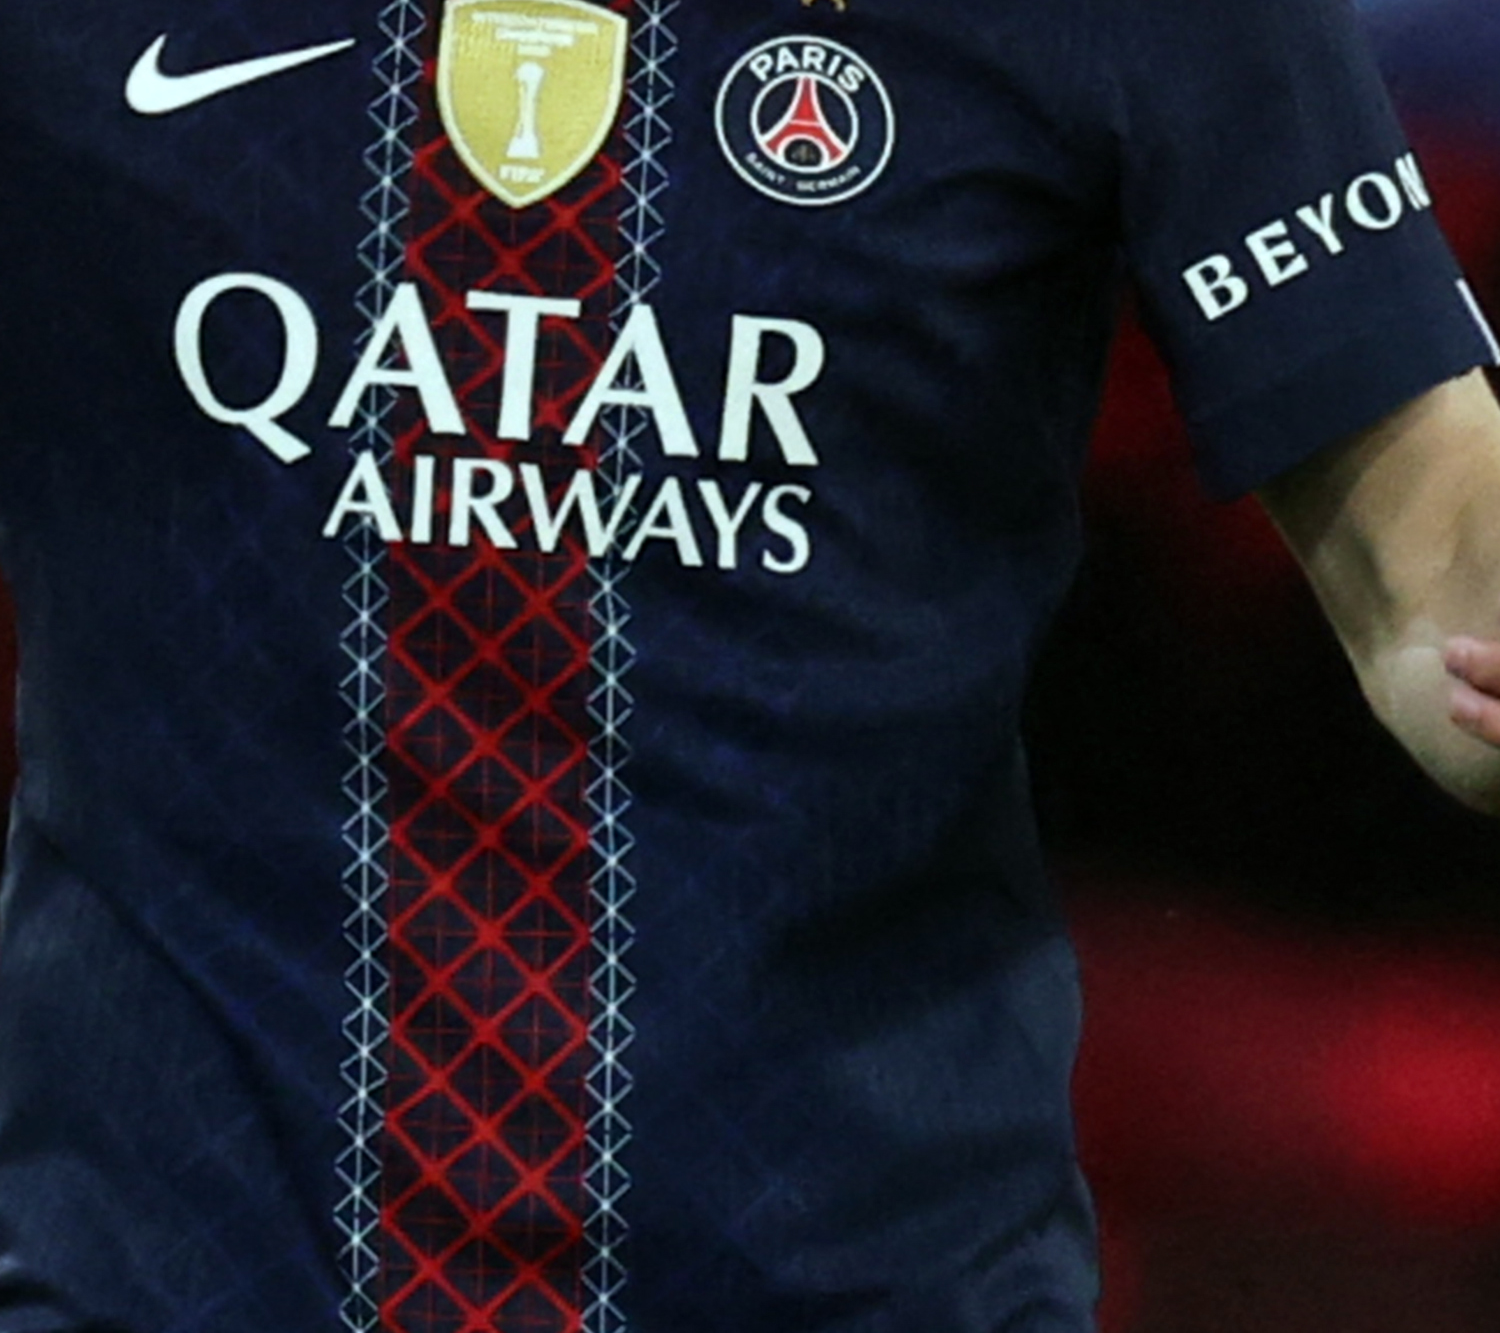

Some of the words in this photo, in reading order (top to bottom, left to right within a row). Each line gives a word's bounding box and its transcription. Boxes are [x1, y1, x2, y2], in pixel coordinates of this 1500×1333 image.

[749, 44, 865, 92] PARIS
[174, 273, 825, 466] QATAR
[323, 450, 812, 574] AIRWAYS
